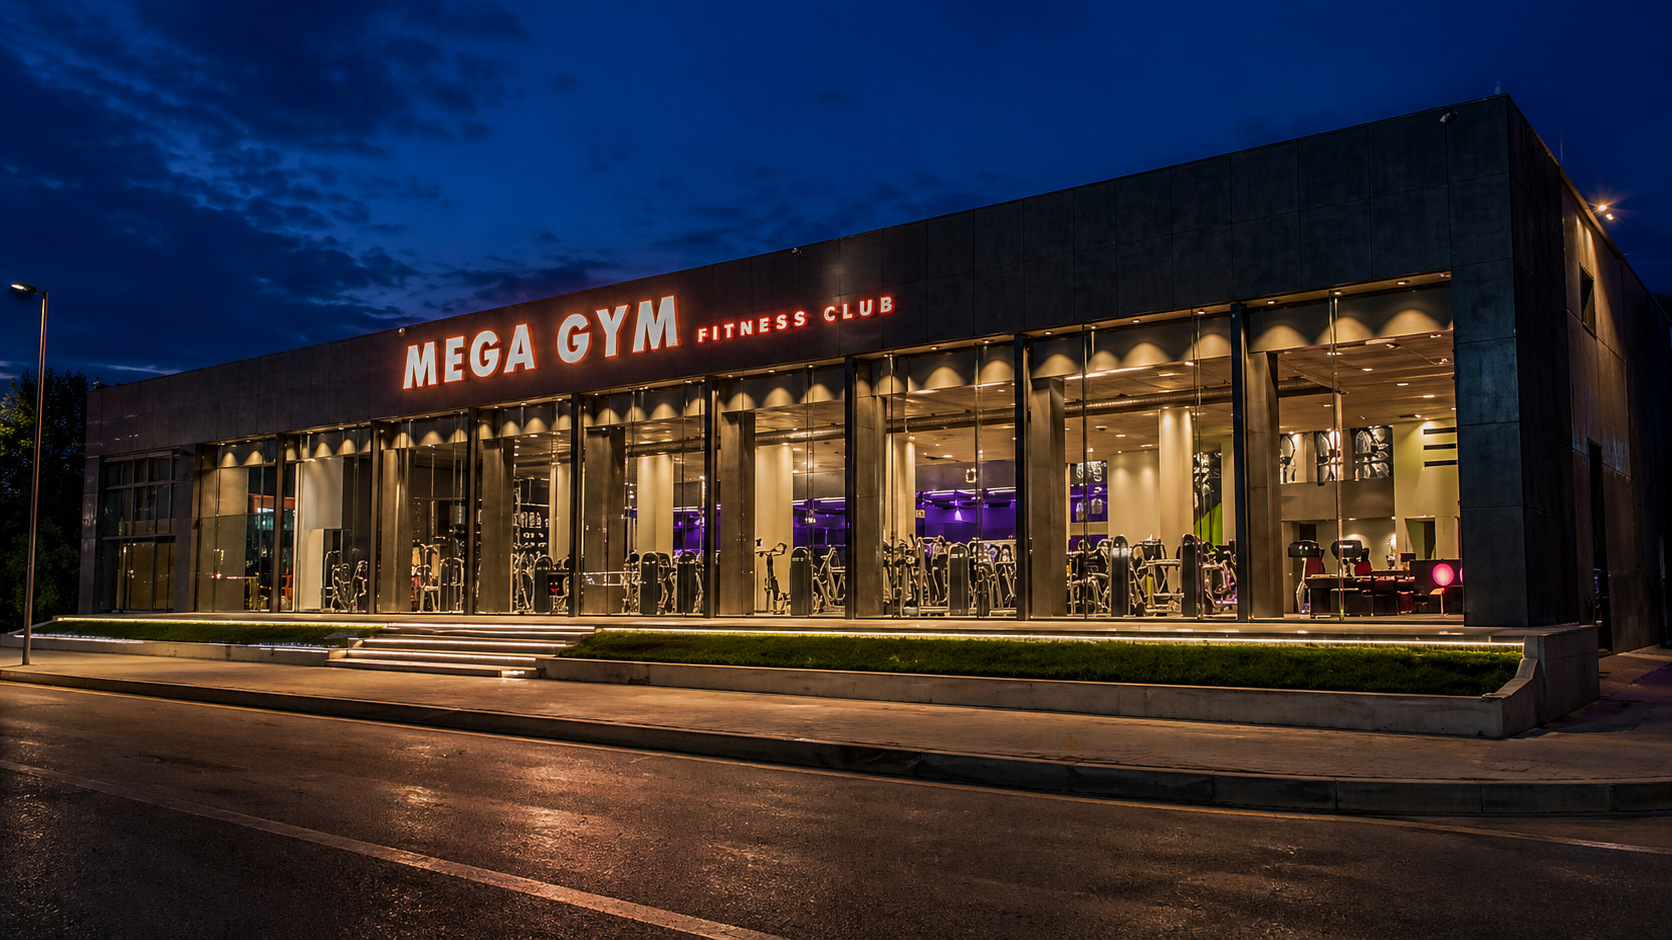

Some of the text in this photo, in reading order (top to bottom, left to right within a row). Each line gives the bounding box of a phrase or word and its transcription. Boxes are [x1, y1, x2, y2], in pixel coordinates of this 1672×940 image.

[403, 295, 680, 390] MEGA GYM
[697, 296, 894, 343] FITNESS CLUB
